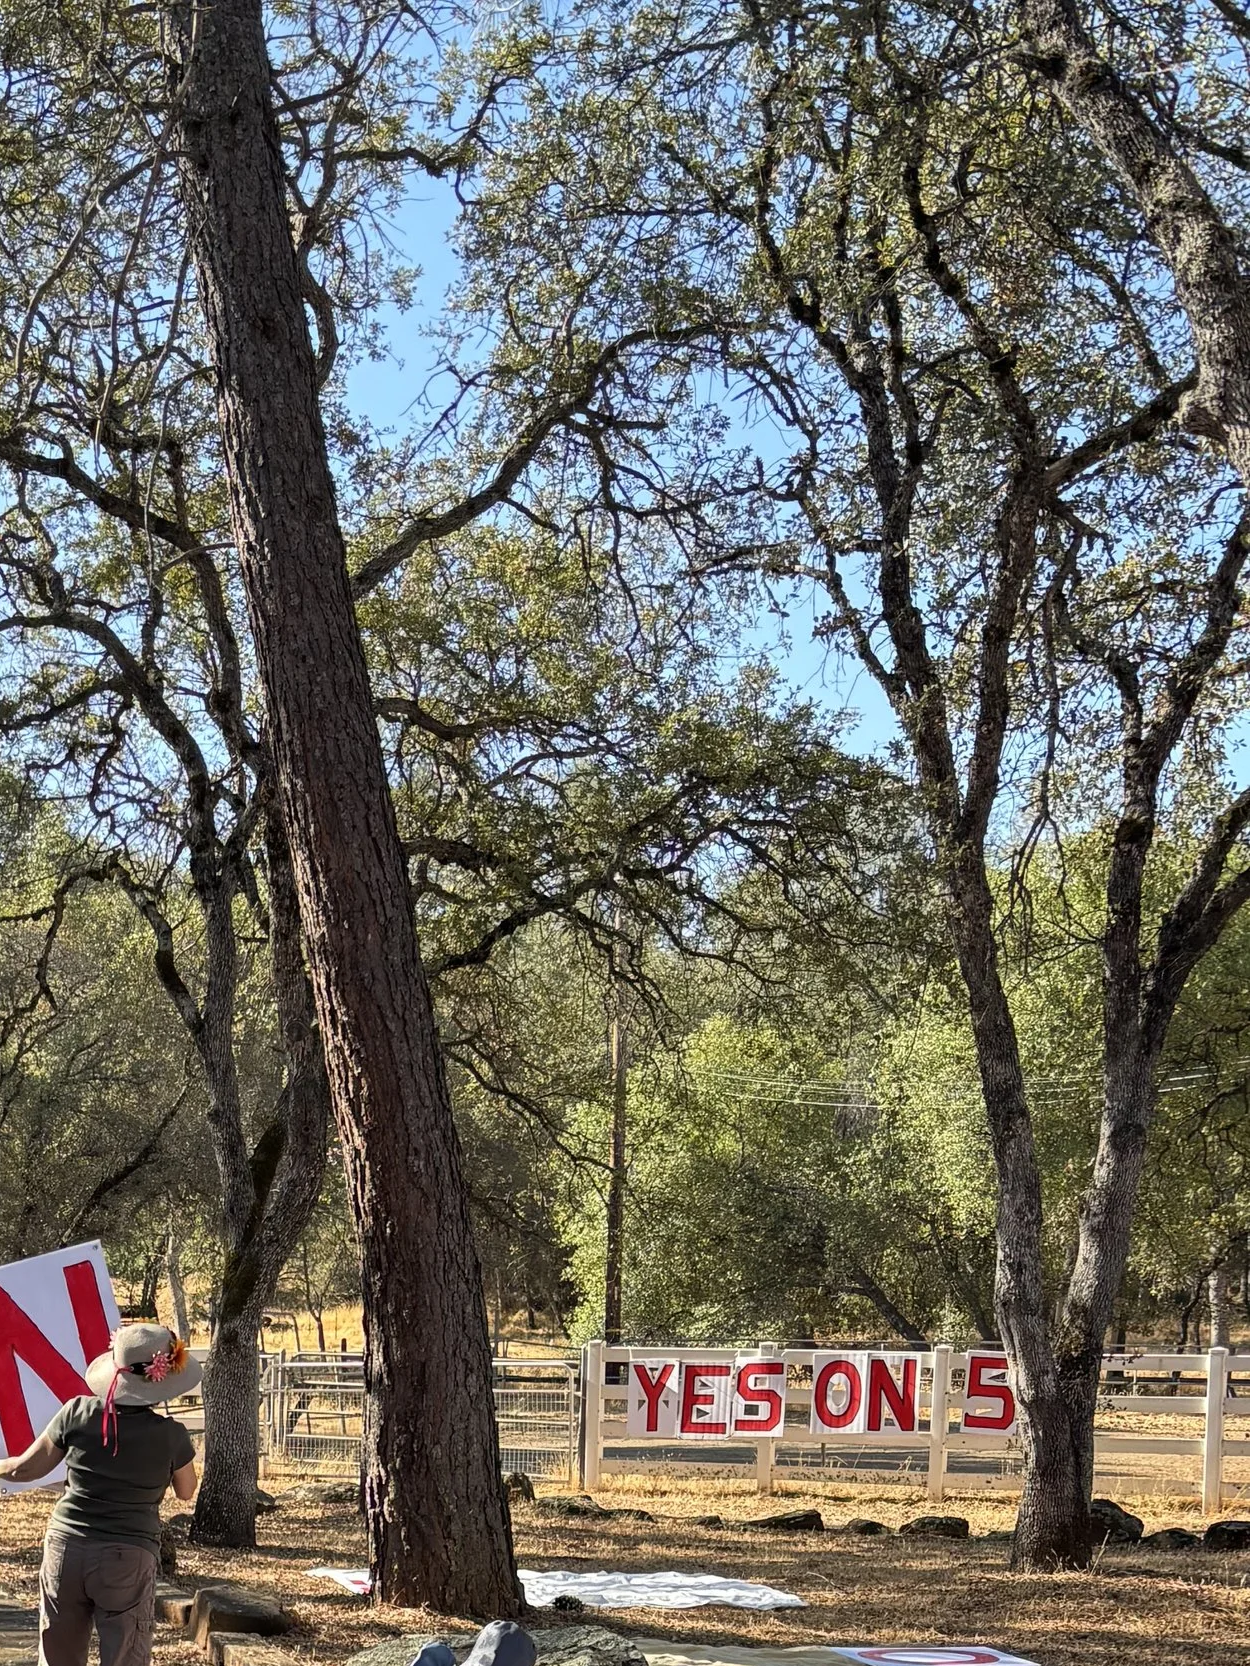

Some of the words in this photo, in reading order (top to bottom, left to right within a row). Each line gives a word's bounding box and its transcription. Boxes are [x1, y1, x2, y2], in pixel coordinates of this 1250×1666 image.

[633, 1362, 784, 1434] YES
[814, 1358, 918, 1432] ON
[963, 1356, 1015, 1431] 5
